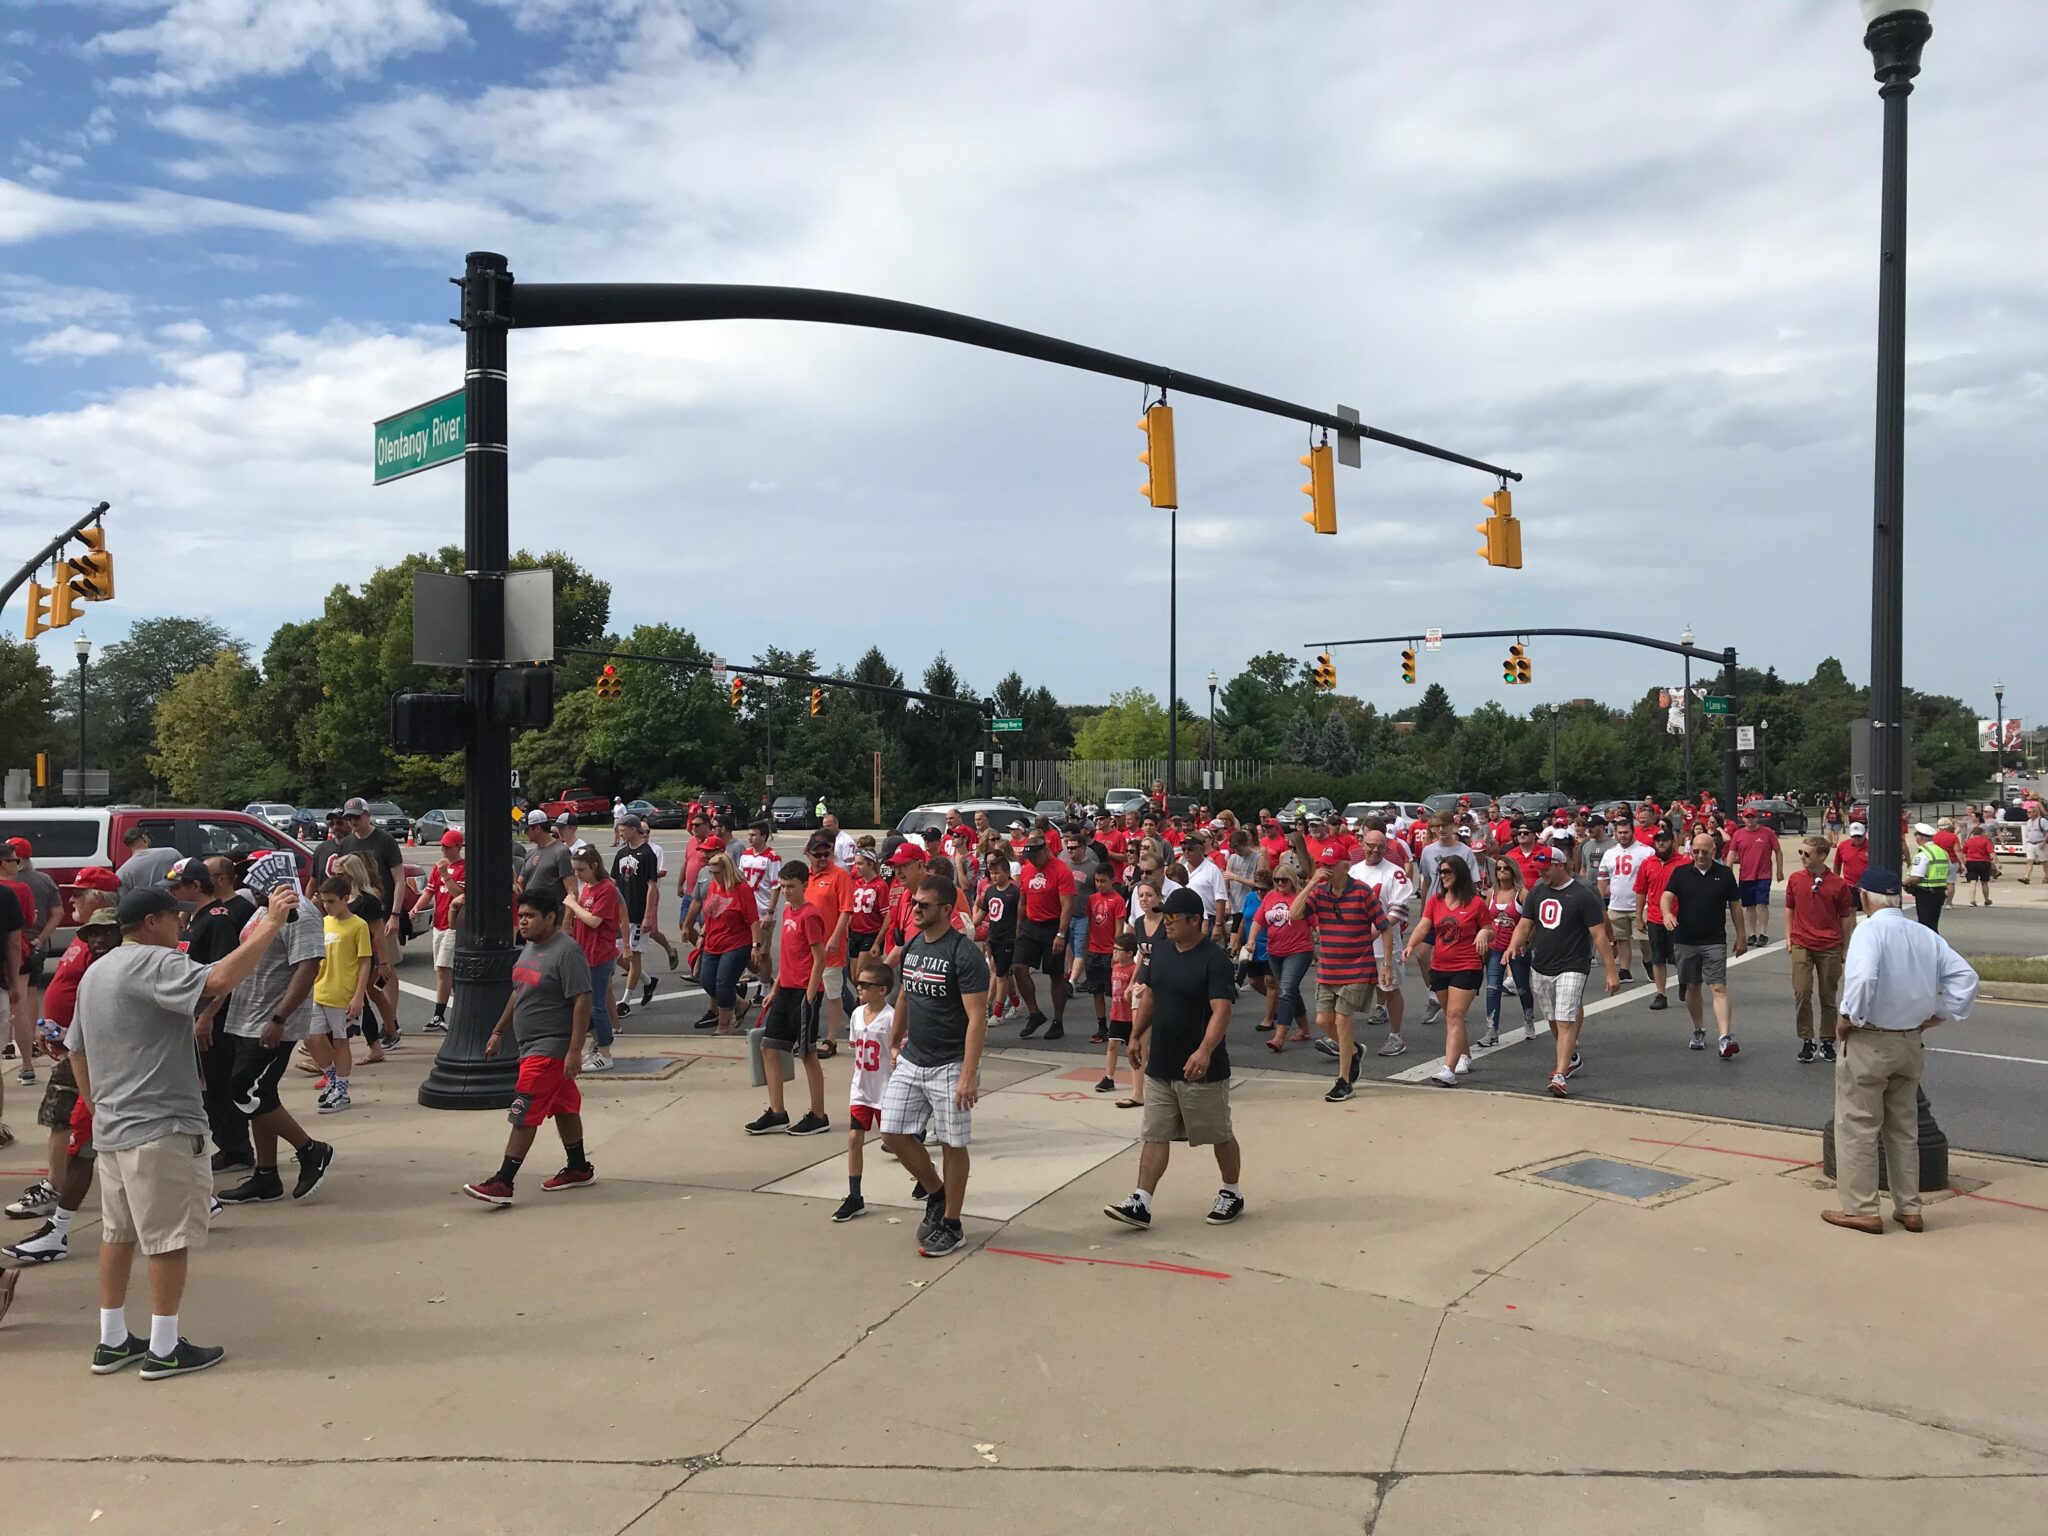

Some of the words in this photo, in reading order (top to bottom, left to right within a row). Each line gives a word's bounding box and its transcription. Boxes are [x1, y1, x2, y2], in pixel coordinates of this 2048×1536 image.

[378, 428, 429, 465] Olentangy
[432, 415, 461, 448] River
[1709, 701, 1720, 710] Lane
[1981, 731, 1994, 748] OHIO
[1615, 854, 1633, 876] 16
[853, 888, 876, 913] 33
[921, 956, 950, 972] STATE
[903, 979, 947, 997] CKEYES
[856, 1039, 880, 1072] 33
